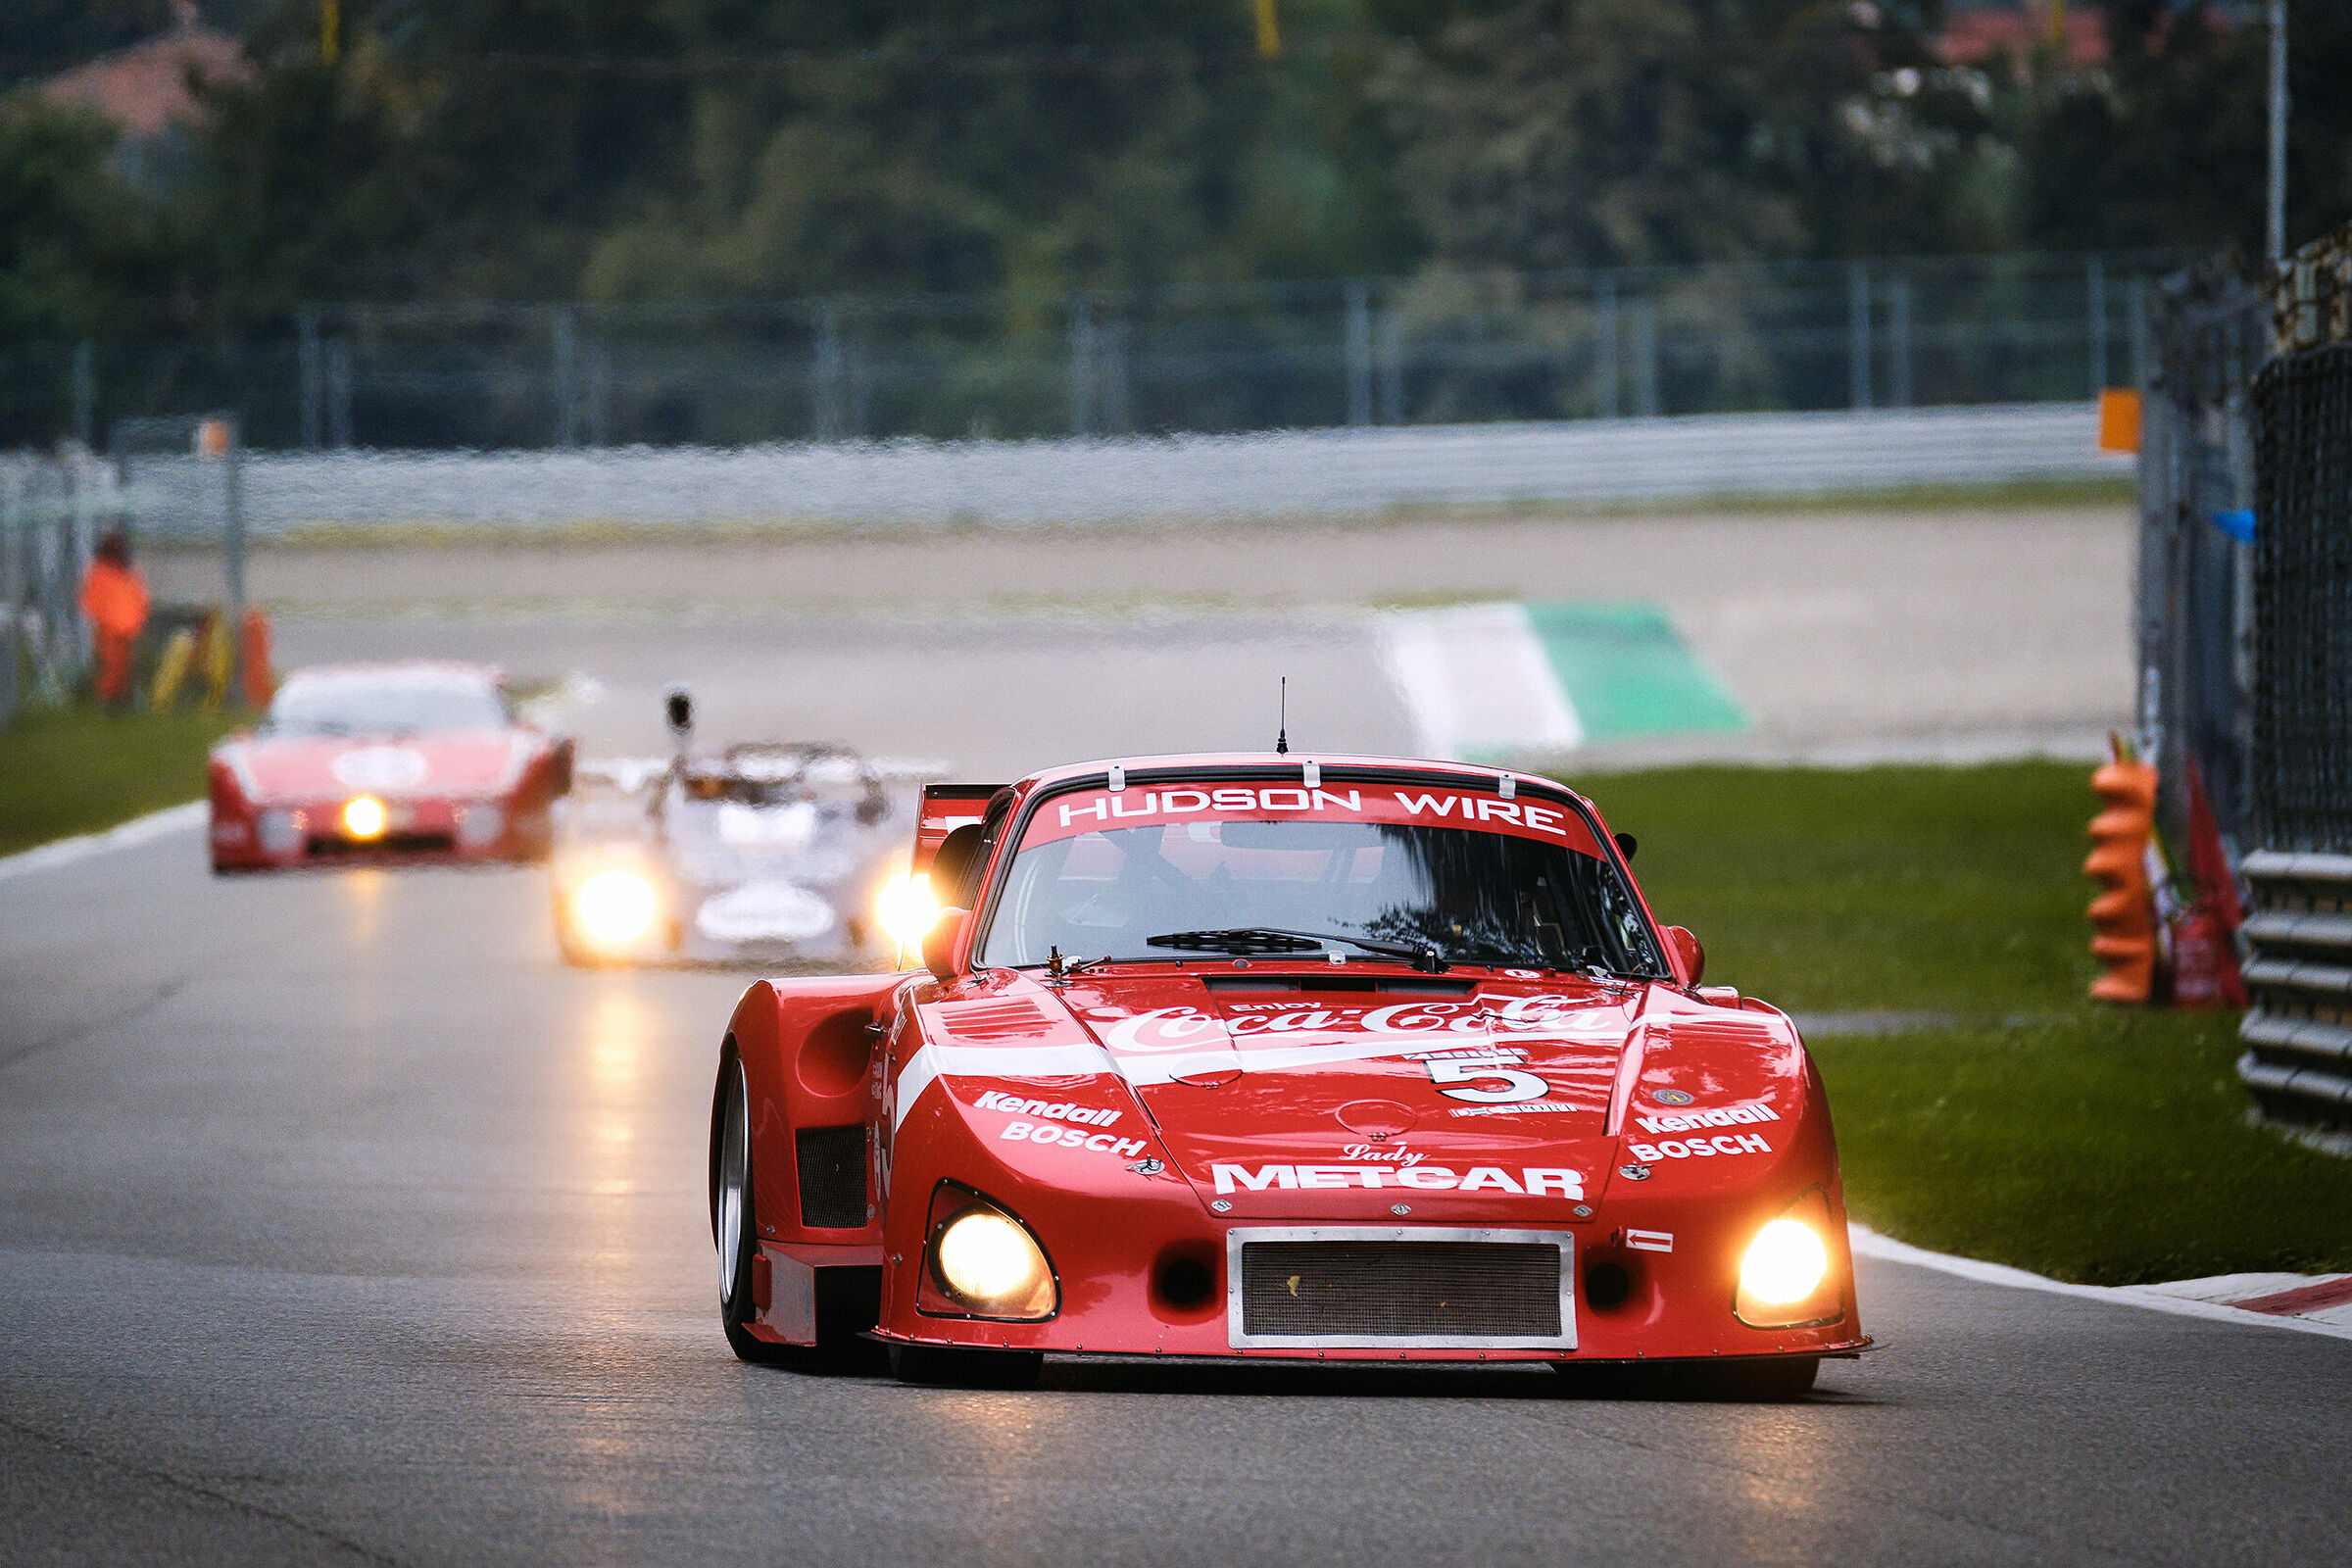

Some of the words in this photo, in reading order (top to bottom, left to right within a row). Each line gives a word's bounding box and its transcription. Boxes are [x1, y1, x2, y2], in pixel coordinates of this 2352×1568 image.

[1059, 788, 1363, 828] HUDSON
[1394, 791, 1567, 836] WIRE
[1106, 993, 1612, 1053] Coca-Cola
[1229, 1002, 1322, 1012] Enjoy
[1424, 1055, 1551, 1103] 5
[973, 1090, 1123, 1128] Kendall
[1634, 1103, 1782, 1135] Kendall
[1000, 1121, 1148, 1157] BOSCH
[1338, 1143, 1431, 1167] Lady
[1627, 1134, 1773, 1162] BOSCH
[1211, 1163, 1585, 1201] METCAR
